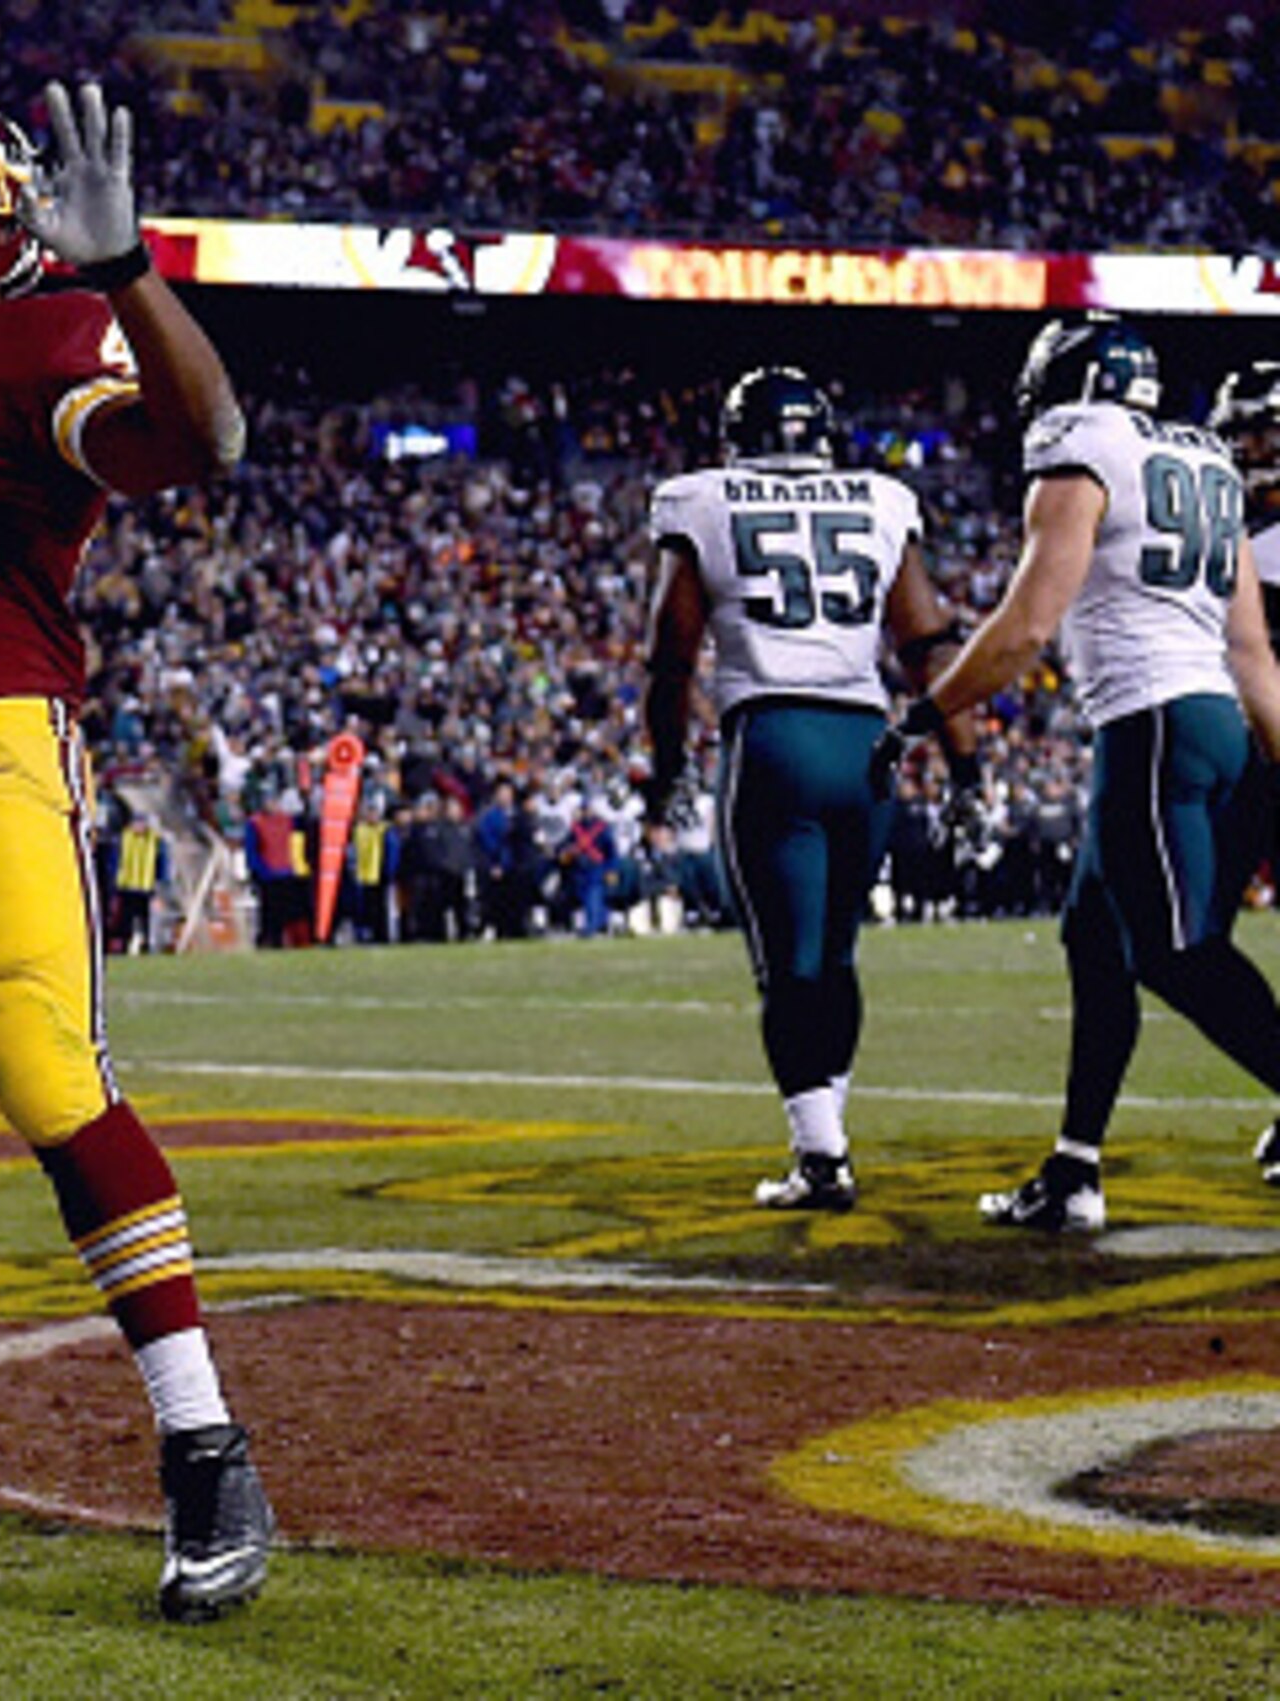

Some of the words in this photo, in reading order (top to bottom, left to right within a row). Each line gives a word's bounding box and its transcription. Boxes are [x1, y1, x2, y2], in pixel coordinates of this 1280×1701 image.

[628, 247, 1045, 309] TOUCHDOWN
[729, 510, 880, 628] 55
[1138, 452, 1244, 598] 98
